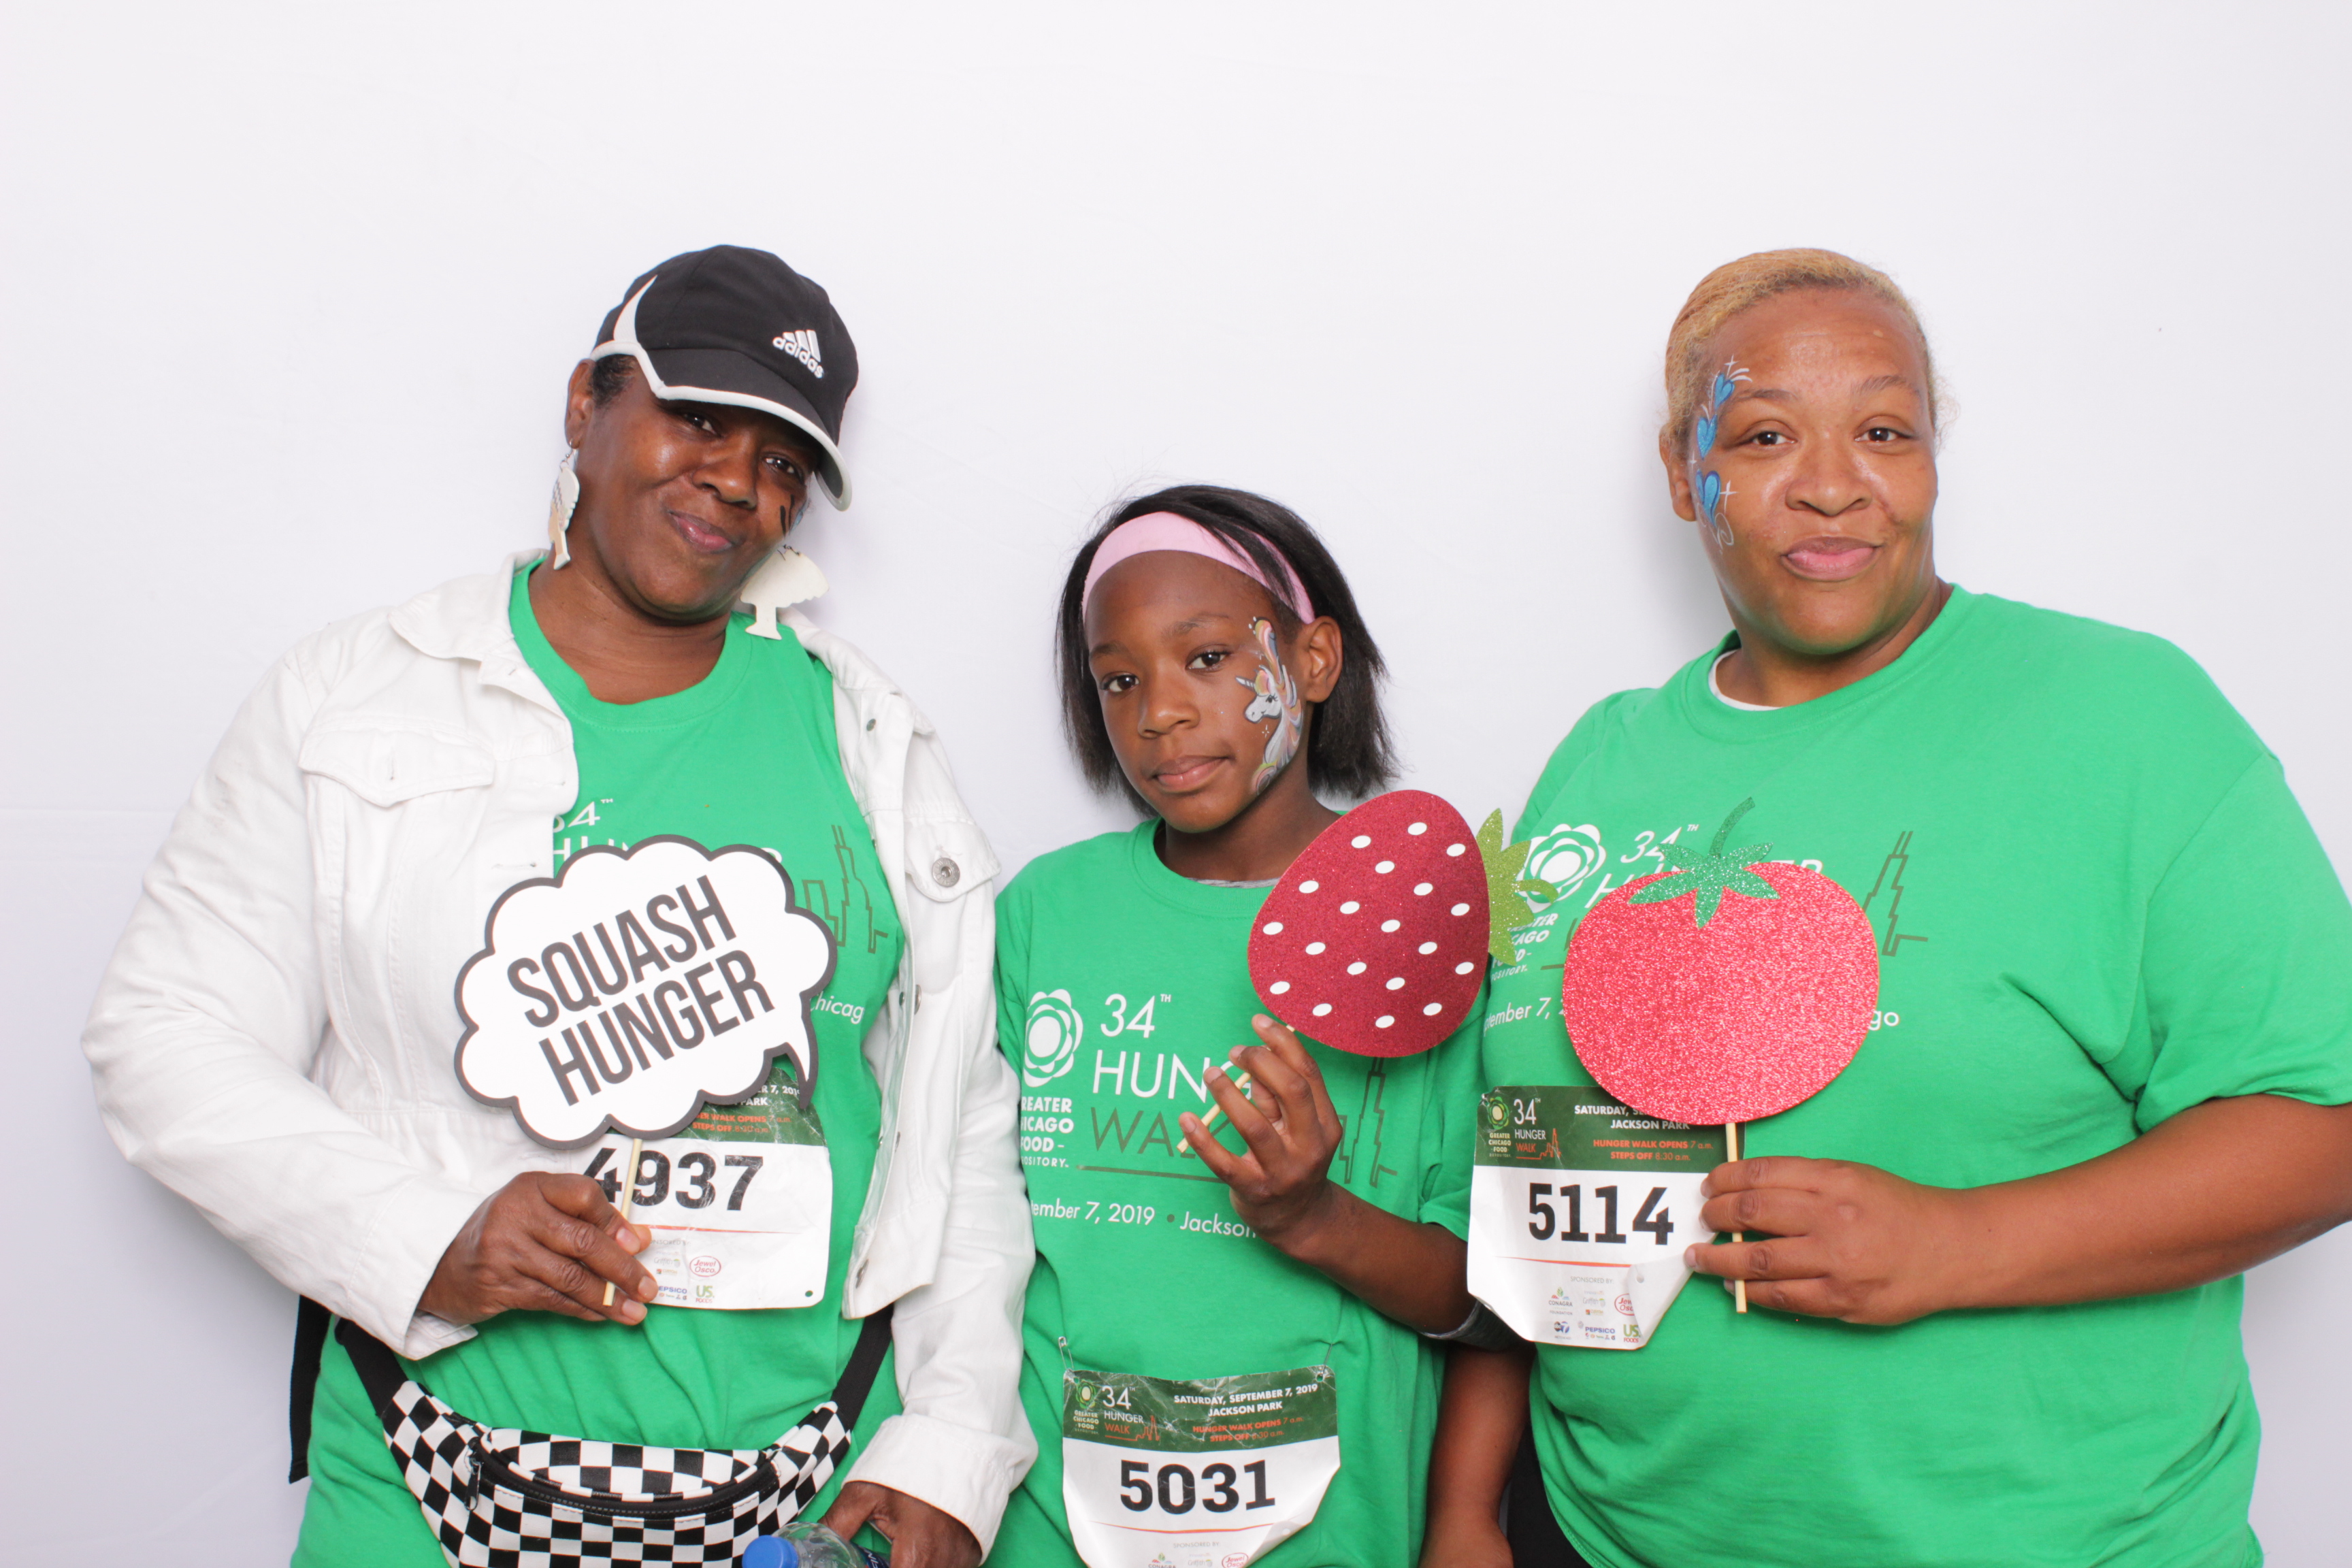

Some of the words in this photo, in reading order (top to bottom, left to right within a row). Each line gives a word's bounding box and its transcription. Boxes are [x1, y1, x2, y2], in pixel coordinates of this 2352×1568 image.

[772, 336, 825, 378] adidas
[1620, 826, 1682, 864] 34
[507, 875, 736, 1028] SQUASH
[810, 991, 864, 1025] hicag
[1100, 993, 1156, 1039] 34
[1160, 994, 1172, 1002] TH
[1536, 997, 1552, 1020] 7,
[538, 950, 775, 1106] HUNGER
[1092, 1049, 1252, 1104] HUN
[1021, 1096, 1073, 1113] REATER
[1514, 1098, 1537, 1125] 34
[1574, 1105, 1629, 1117] SATURDAY,
[711, 1113, 736, 1122] WALK
[737, 1115, 767, 1123] OPENS
[1021, 1116, 1075, 1134] ICAGO
[1610, 1119, 1660, 1130] JACKSON
[1661, 1120, 1690, 1130] PARK
[692, 1122, 715, 1131] STEPS
[1514, 1128, 1547, 1140] HUNGER
[1516, 1143, 1537, 1153] WALK
[1592, 1139, 1631, 1148] HUNGER
[1631, 1140, 1658, 1148] WALK
[1659, 1141, 1688, 1149] OPENS
[1690, 1140, 1697, 1148] 7
[1610, 1152, 1635, 1160] STEPS
[583, 1147, 764, 1211] 4937
[1030, 1197, 1081, 1220] tember
[1084, 1200, 1100, 1224] 7,
[1107, 1203, 1156, 1226] 2019
[1528, 1181, 1675, 1246] 5114
[1570, 1276, 1605, 1284] SPONSORED
[658, 1286, 688, 1294] EPSICO
[1585, 1326, 1616, 1335] PEPSICO
[1102, 1385, 1132, 1410] 34
[1174, 1395, 1226, 1406] SATURDAY,
[1229, 1389, 1284, 1404] SEPTEMBER
[1296, 1384, 1319, 1395] 2019
[1074, 1409, 1098, 1418] GREATER
[1104, 1410, 1144, 1424] HUNGER
[1208, 1405, 1255, 1418] JACKSON
[1257, 1401, 1284, 1412] PARK
[1073, 1416, 1100, 1425] CHICAGO
[1105, 1422, 1130, 1434] WALK
[1193, 1425, 1228, 1433] HUNGER
[1229, 1423, 1253, 1431] WALK
[1254, 1418, 1281, 1429] OPENS
[1209, 1434, 1233, 1443] STEPS
[1234, 1433, 1250, 1441] OFF
[1120, 1458, 1276, 1515] 5031
[1226, 1554, 1245, 1563] Jewel
